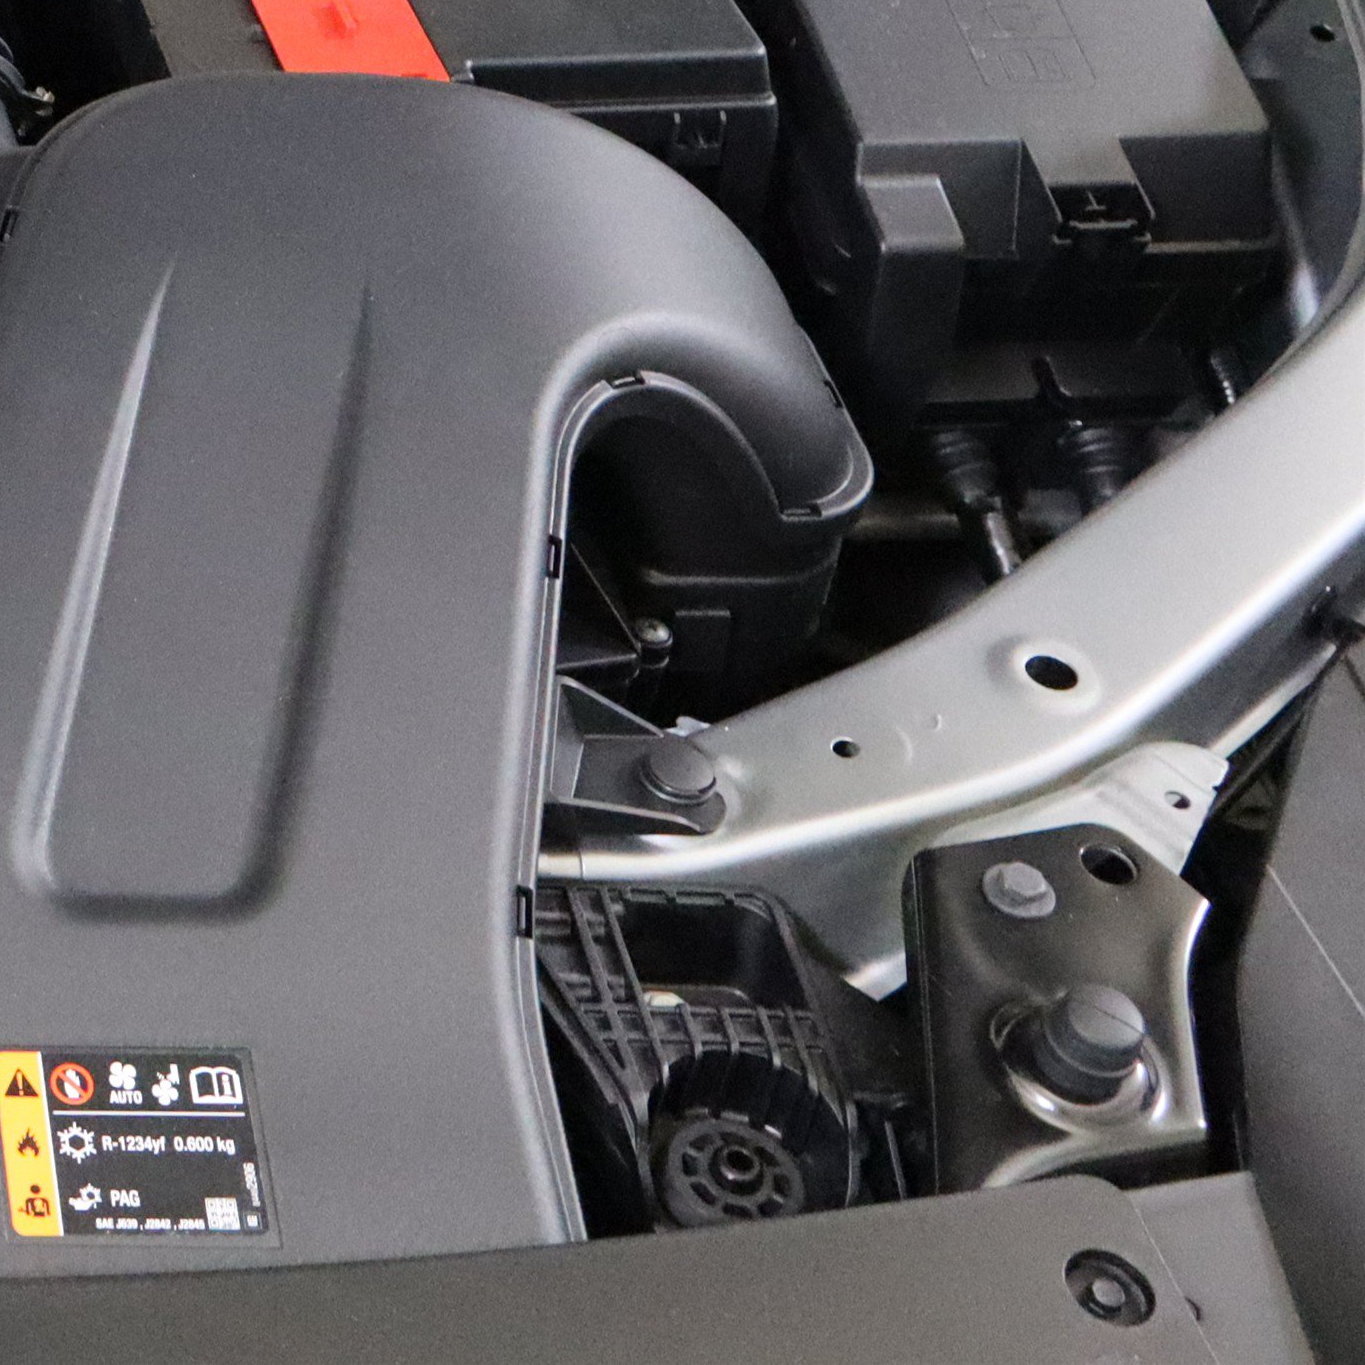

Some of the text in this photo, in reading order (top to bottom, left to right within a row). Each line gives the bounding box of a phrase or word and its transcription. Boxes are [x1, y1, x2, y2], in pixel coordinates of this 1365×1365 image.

[109, 1090, 143, 1105] AUTO
[101, 1136, 236, 1155] R-1234yf 0.600 kg
[110, 1189, 141, 1208] PAG
